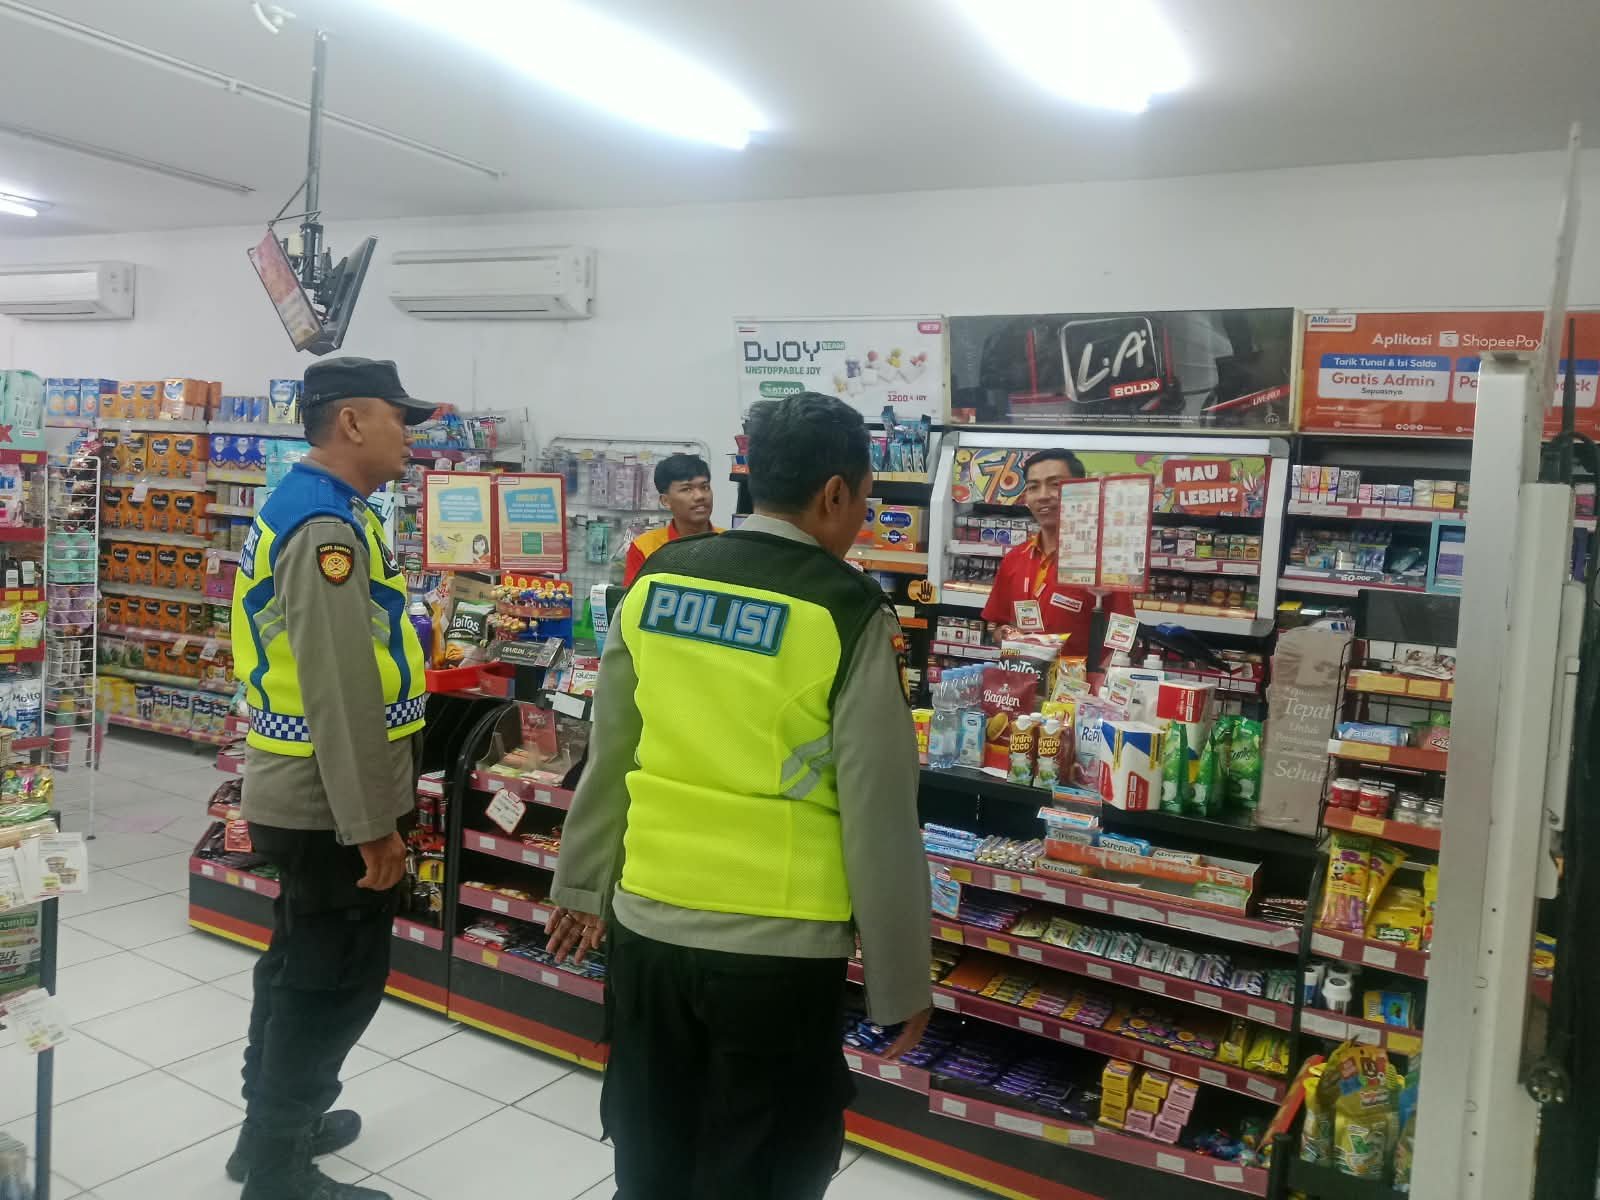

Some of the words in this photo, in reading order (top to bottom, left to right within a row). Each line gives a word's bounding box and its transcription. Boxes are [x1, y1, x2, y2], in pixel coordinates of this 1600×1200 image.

[1371, 333, 1433, 348] Aplikasi
[1462, 335, 1544, 351] ShopeePay
[743, 340, 821, 362] DJOY
[745, 366, 805, 376] UNSTOPPABLE
[1333, 357, 1356, 367] Tarik
[1356, 358, 1387, 367] Tunai
[1397, 359, 1409, 368] Isi
[1410, 359, 1438, 369] Saldo
[1331, 372, 1380, 386] Gratis
[1383, 373, 1436, 388] Admin
[1114, 382, 1151, 398] BOLD
[1174, 464, 1220, 483] MAU
[1178, 488, 1238, 506] LEBIH?
[646, 587, 782, 649] POLISI
[12, 691, 41, 704] Molto
[983, 689, 1021, 710] Bagelen
[1009, 734, 1033, 745] Hydro
